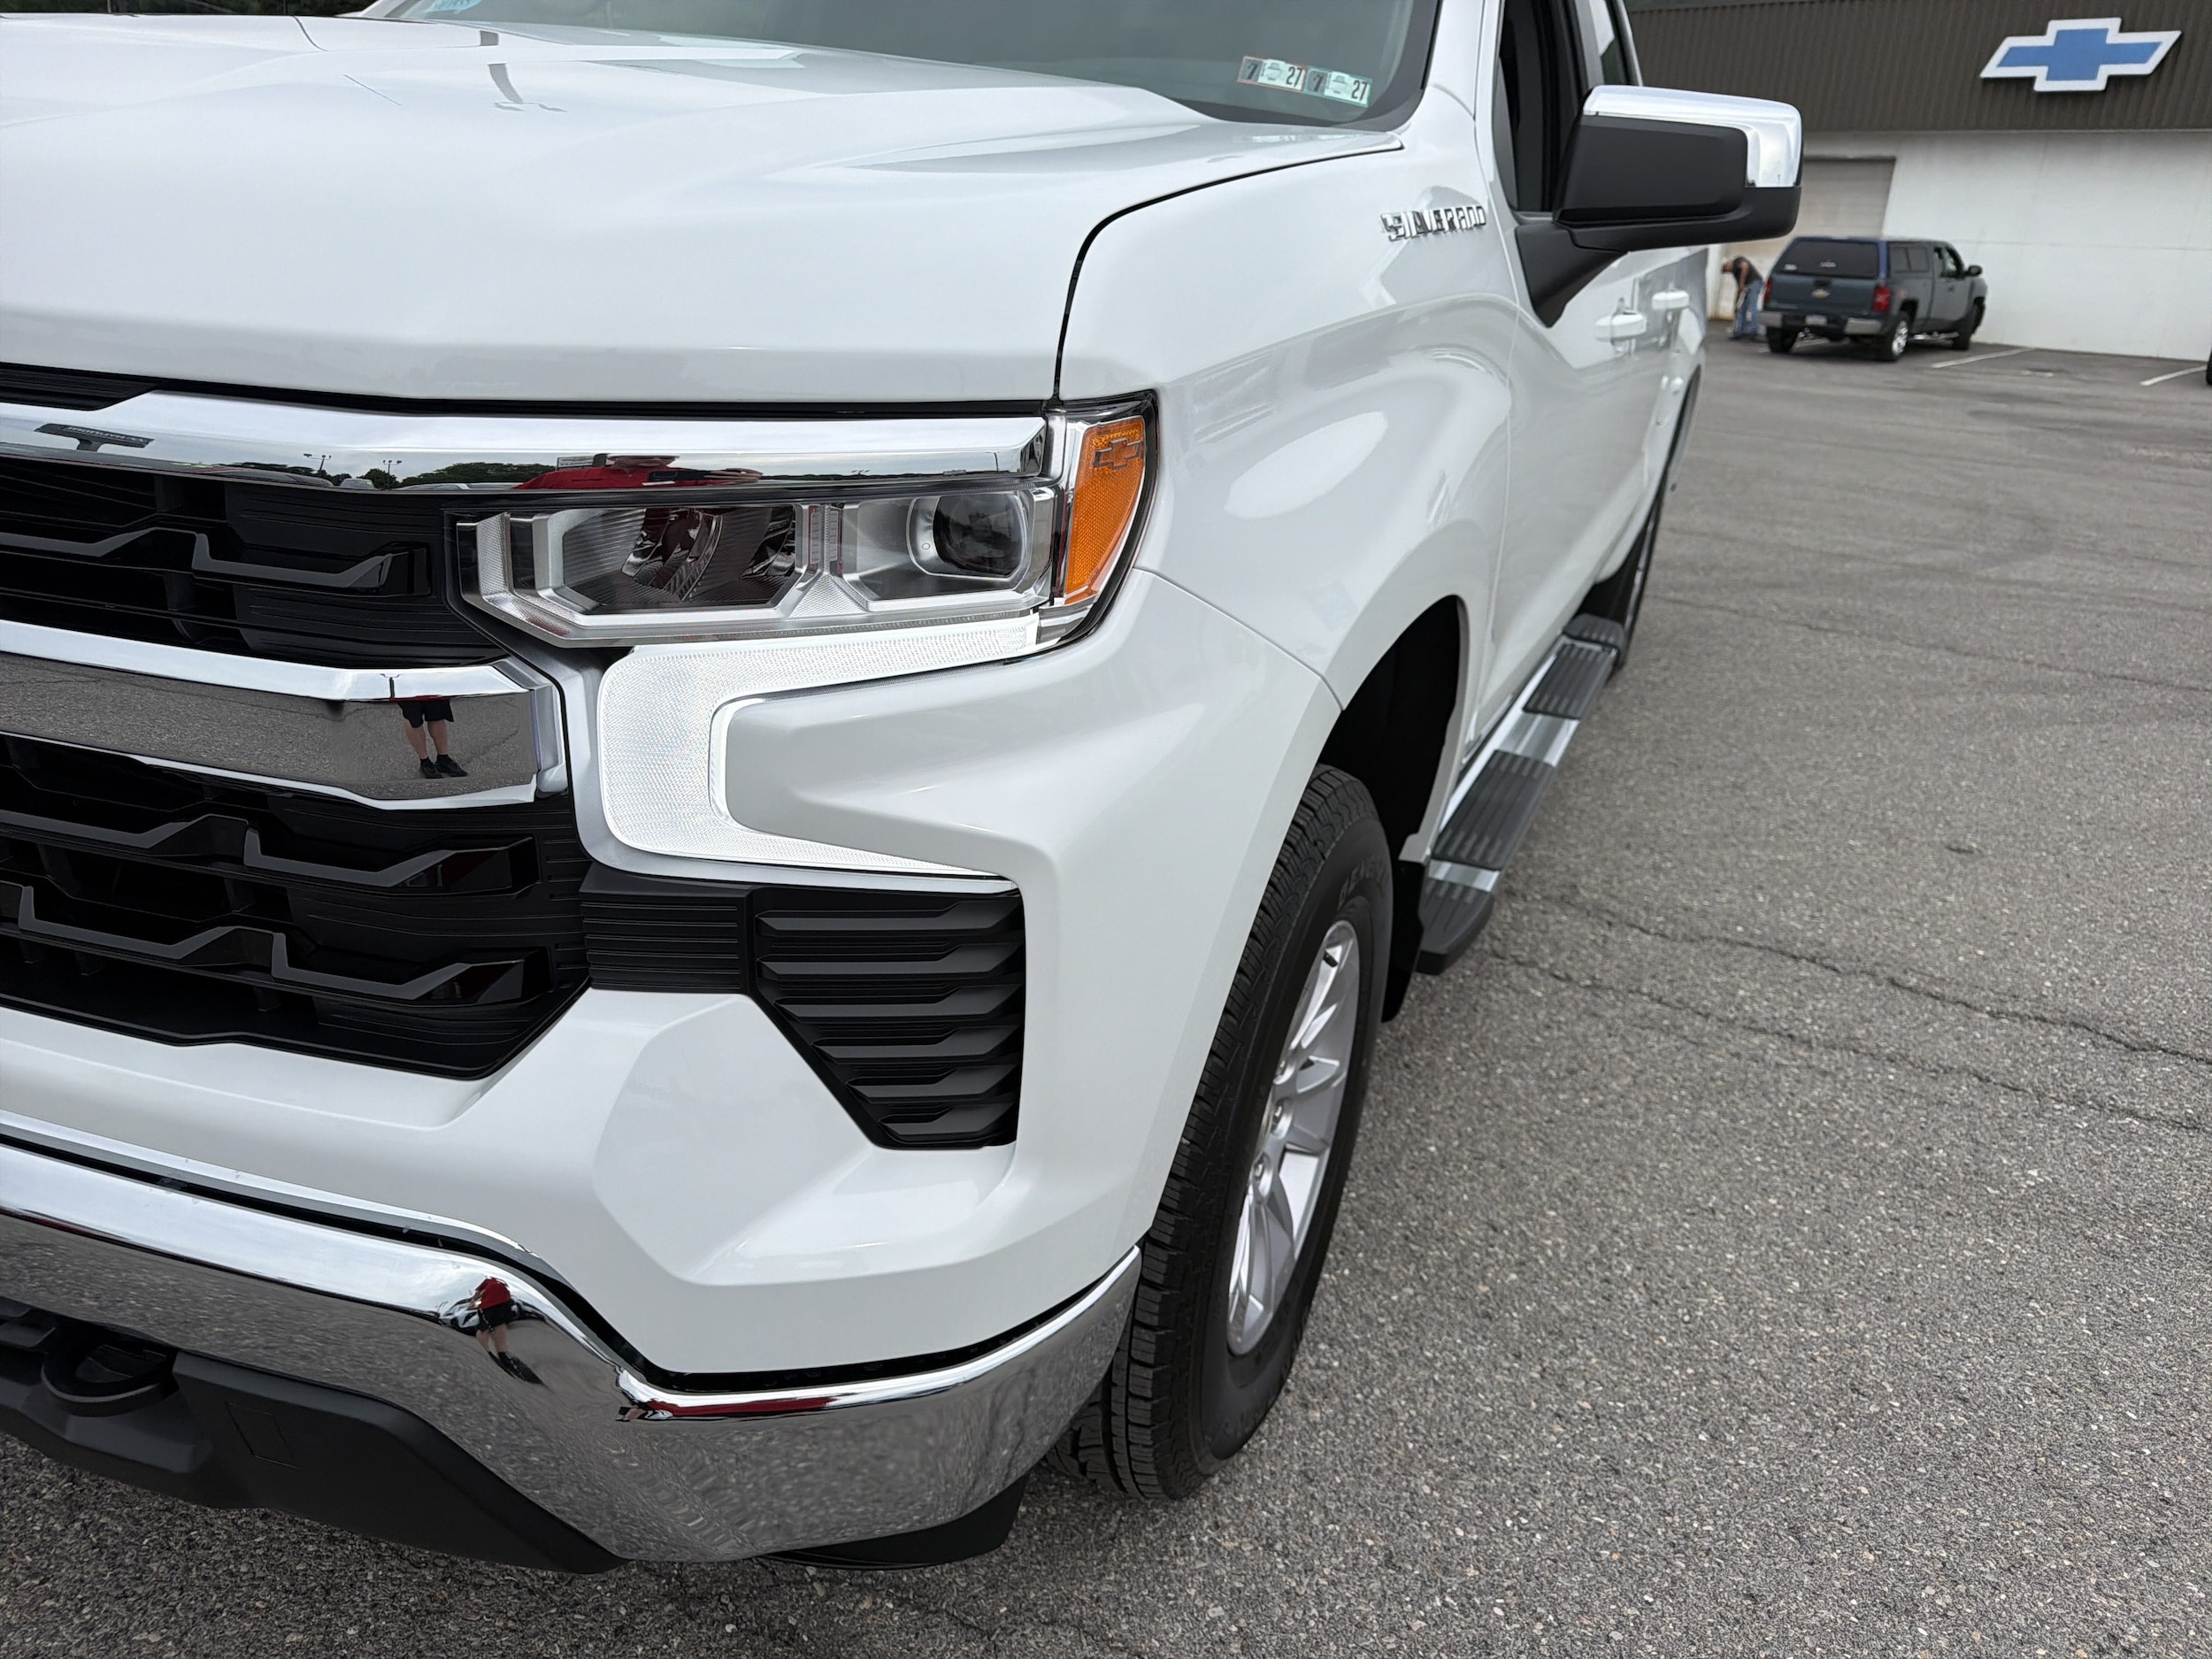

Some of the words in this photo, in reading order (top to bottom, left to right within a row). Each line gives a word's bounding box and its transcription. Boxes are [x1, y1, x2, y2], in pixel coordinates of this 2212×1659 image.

[1285, 66, 1302, 88] 27
[1350, 80, 1368, 102] 27
[1380, 205, 1486, 242] SILVERADO
